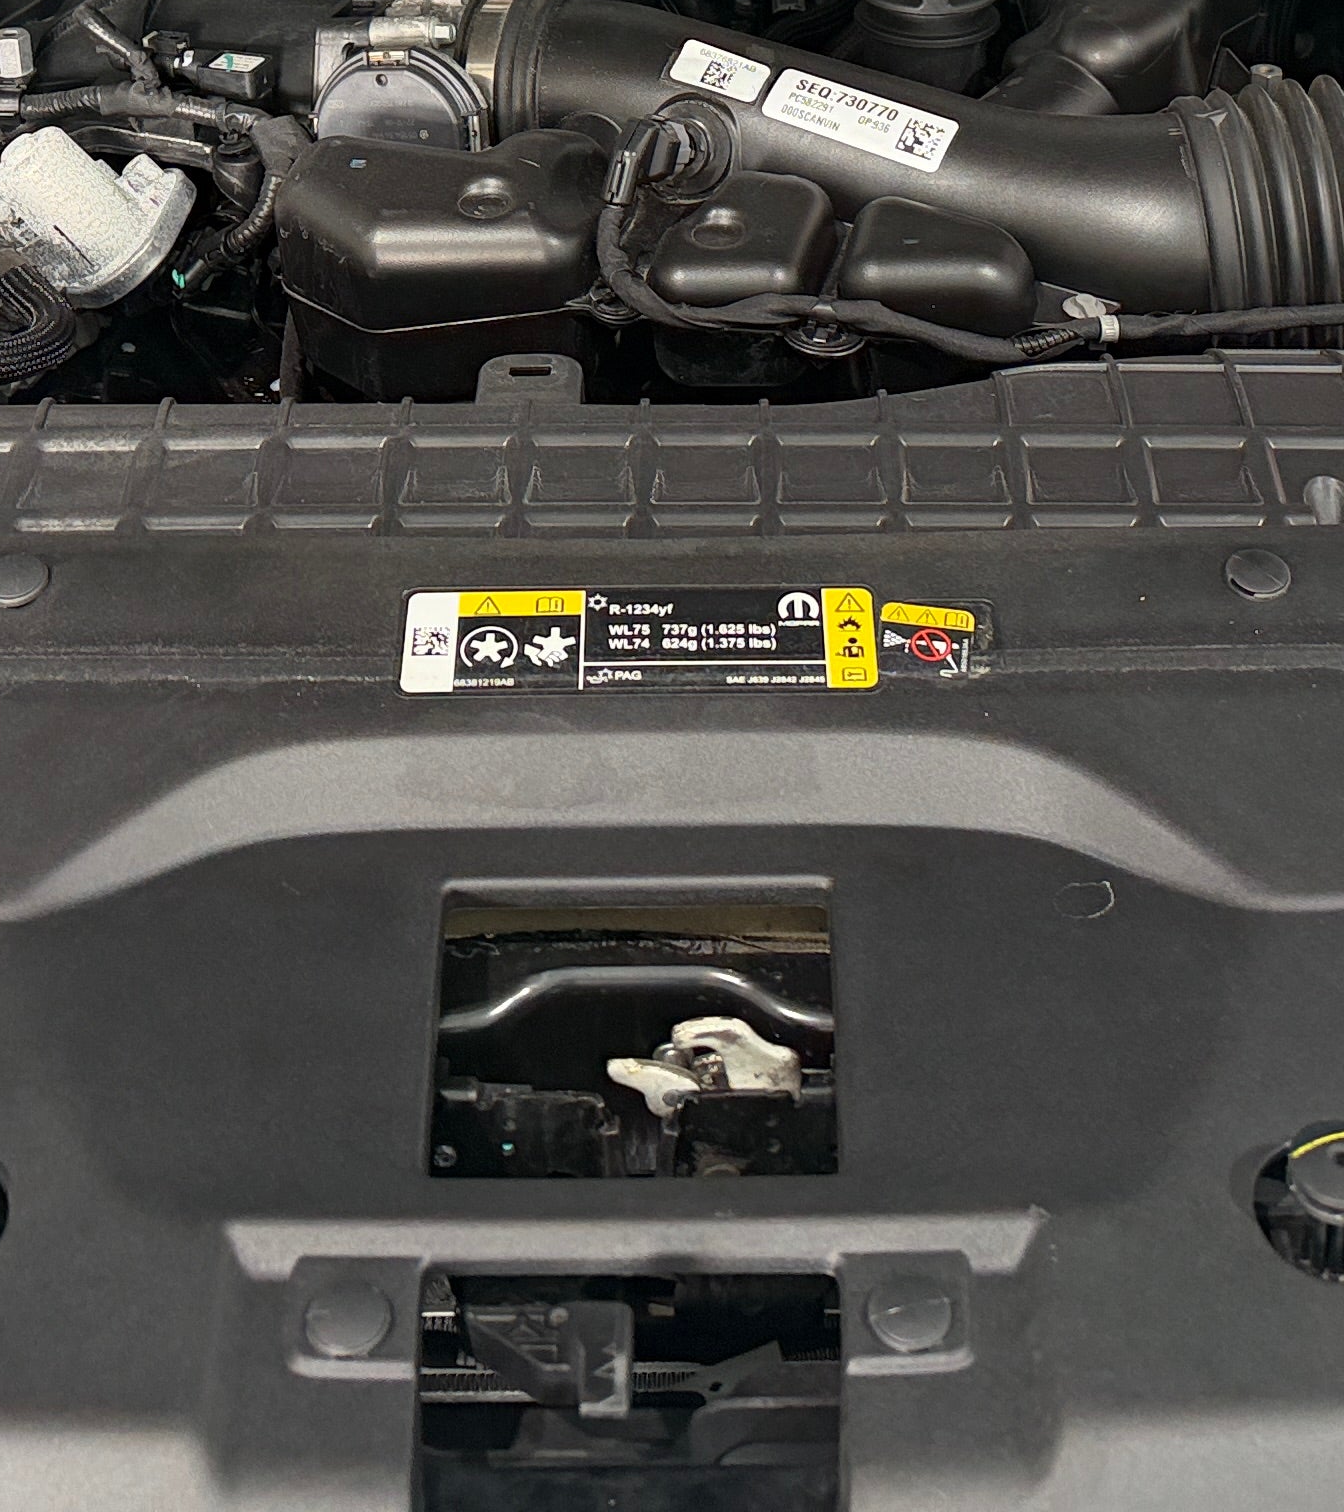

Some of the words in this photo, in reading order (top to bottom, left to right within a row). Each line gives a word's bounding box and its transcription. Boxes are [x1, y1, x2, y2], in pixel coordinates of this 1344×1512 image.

[795, 77, 899, 122] SEQ:730770
[609, 603, 674, 617] R-1234yf
[608, 624, 651, 636] WL75
[661, 624, 698, 638] 737g
[701, 623, 746, 637] (1.625
[748, 623, 777, 637] lbs)
[608, 637, 651, 650] WL74
[661, 637, 698, 652] 624g
[701, 637, 746, 651] (1.375
[748, 637, 777, 651] lbs)
[614, 670, 643, 681] PAG
